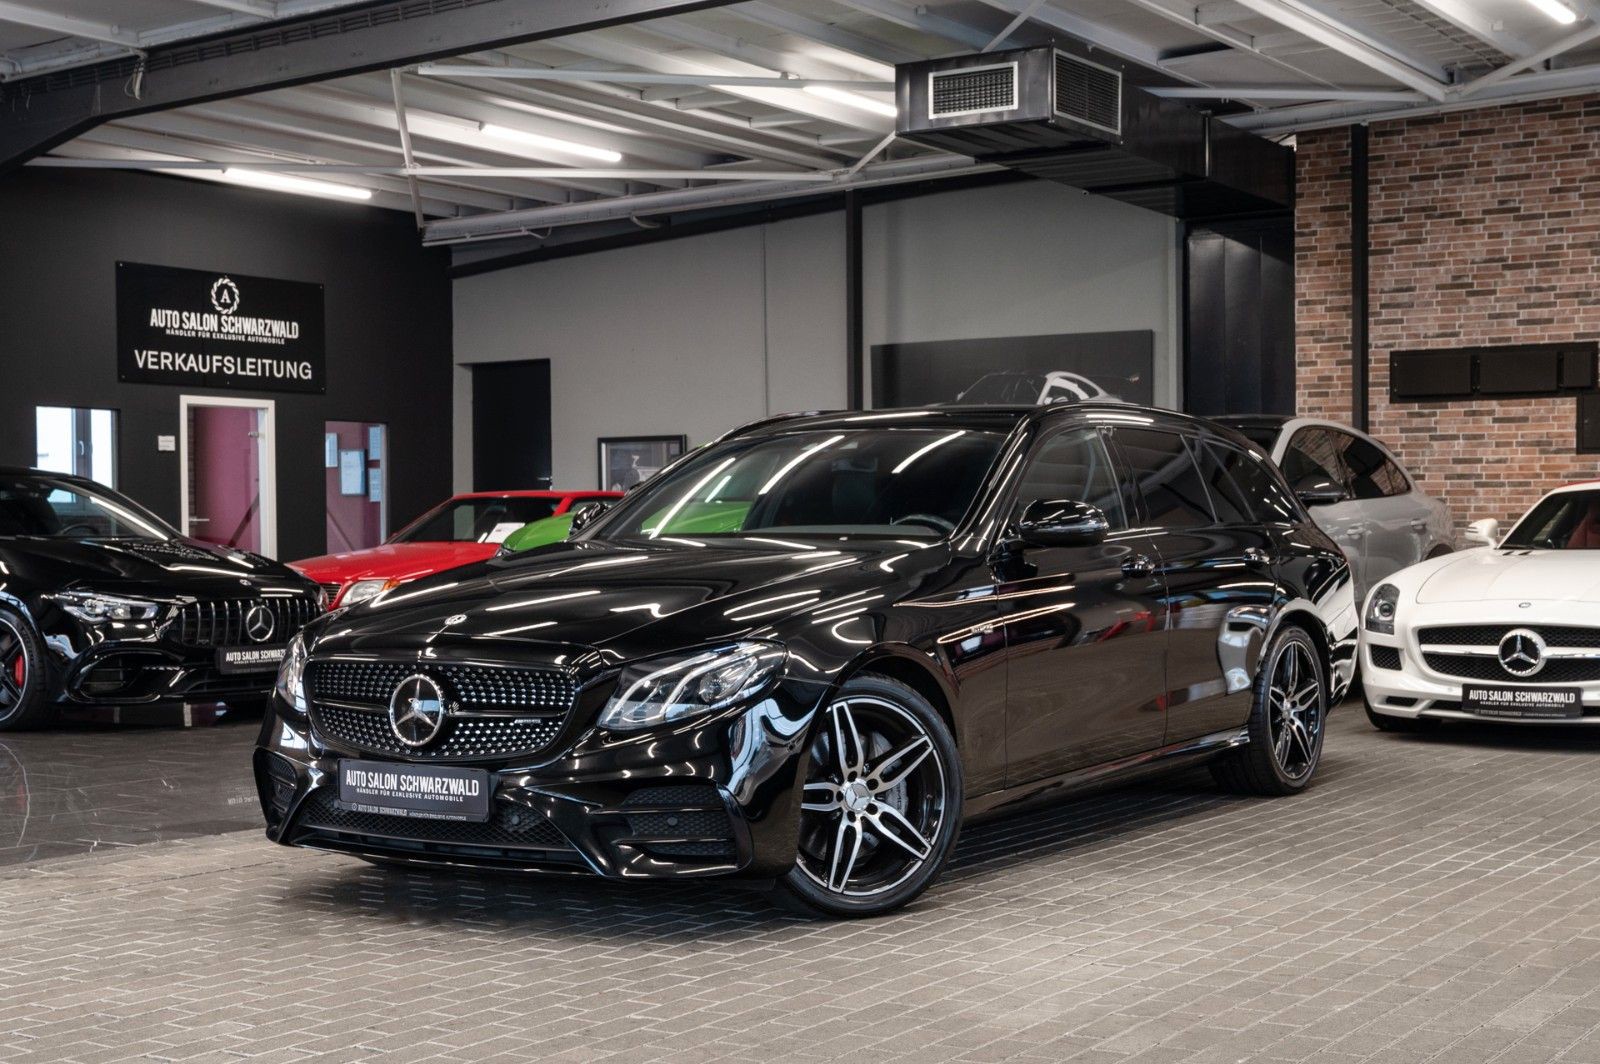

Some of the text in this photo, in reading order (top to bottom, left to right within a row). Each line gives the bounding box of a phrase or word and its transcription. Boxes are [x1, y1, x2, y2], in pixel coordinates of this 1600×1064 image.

[150, 308, 299, 339] AUTO SALON SCHWARZWALD
[166, 328, 286, 345] HÄNDLER FÜR EXKLUSIVE AUTOMOBILE
[134, 350, 312, 380] VERKAUFSLEITUNG
[226, 652, 241, 662] AUTO
[242, 651, 260, 660] SALON
[1469, 689, 1576, 704] AUTO SALON SCHWARZWALD
[346, 769, 479, 796] AUTO SALON SCHWARZWALD
[356, 787, 464, 802] HÄNDLER FÜR EXKLUSIVE AUTOMOBILE
